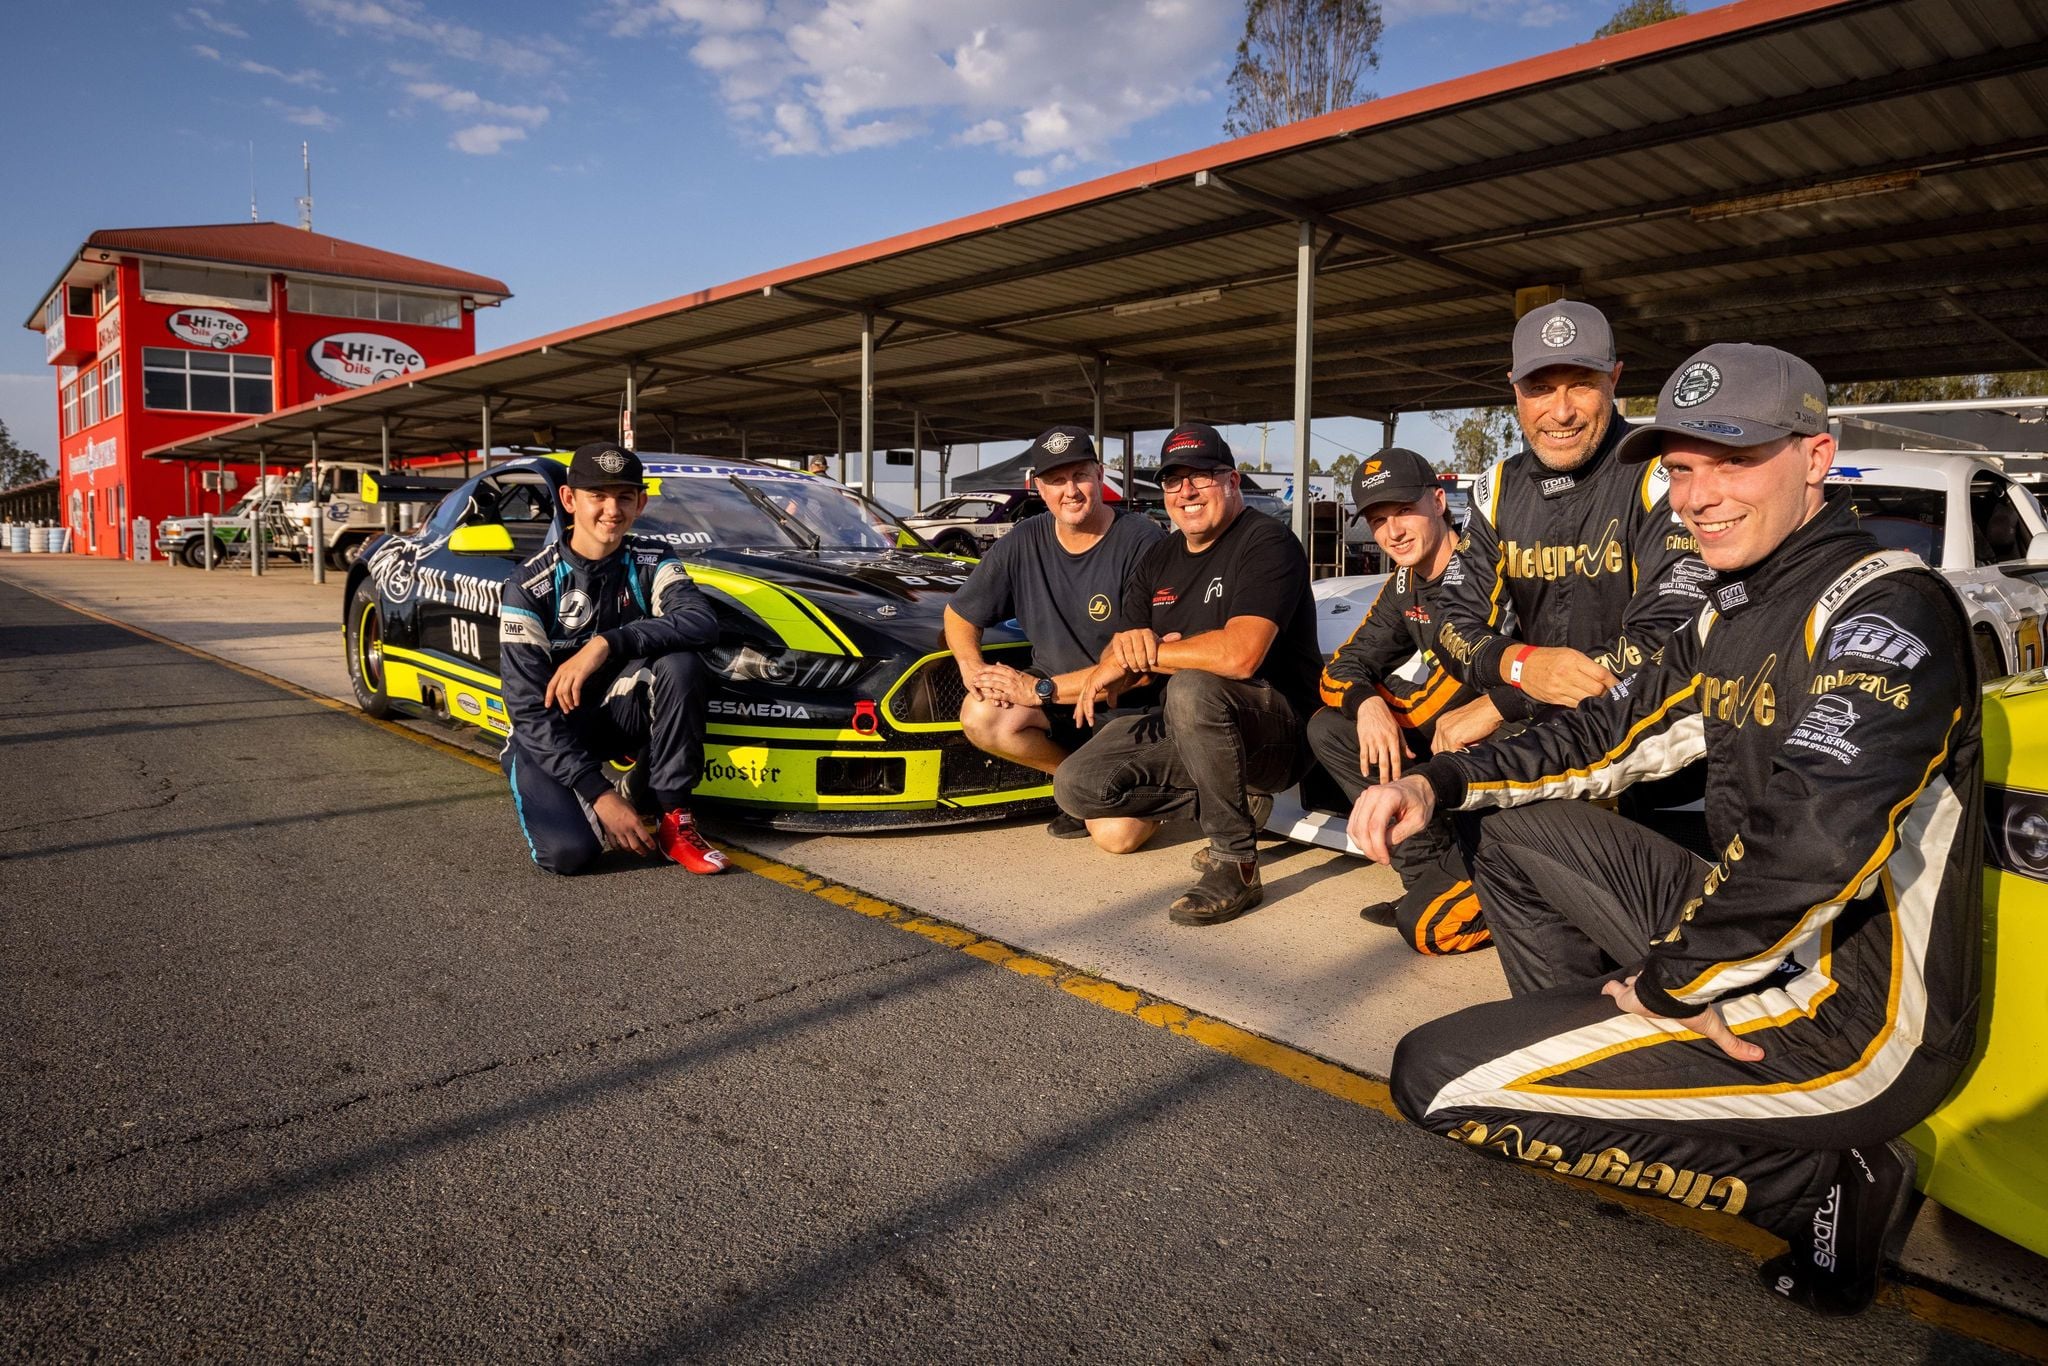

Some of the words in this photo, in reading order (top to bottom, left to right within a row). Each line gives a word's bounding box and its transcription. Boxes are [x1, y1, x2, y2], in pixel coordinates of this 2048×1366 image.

[192, 327, 211, 336] Oils
[194, 315, 244, 331] Hi-Tec
[348, 342, 419, 366] Hi-Tec
[344, 362, 372, 375] Oils
[1361, 470, 1392, 488] boost
[1480, 475, 1490, 501] rpm
[1543, 475, 1571, 490] rpm
[636, 553, 659, 564] OMP
[1506, 518, 1623, 581] helgrave
[531, 580, 553, 598] OMP
[1674, 582, 1696, 593] LYNTON
[1822, 557, 1889, 603] rpm
[416, 566, 448, 603] FULL
[452, 573, 503, 618] THROTT
[1719, 583, 1744, 602] rpm
[504, 622, 524, 635] OMP
[450, 616, 481, 660] BBQ
[1809, 732, 1826, 743] BM
[1823, 734, 1861, 758] SERVICE
[1447, 1120, 1748, 1216] Chelgrave
